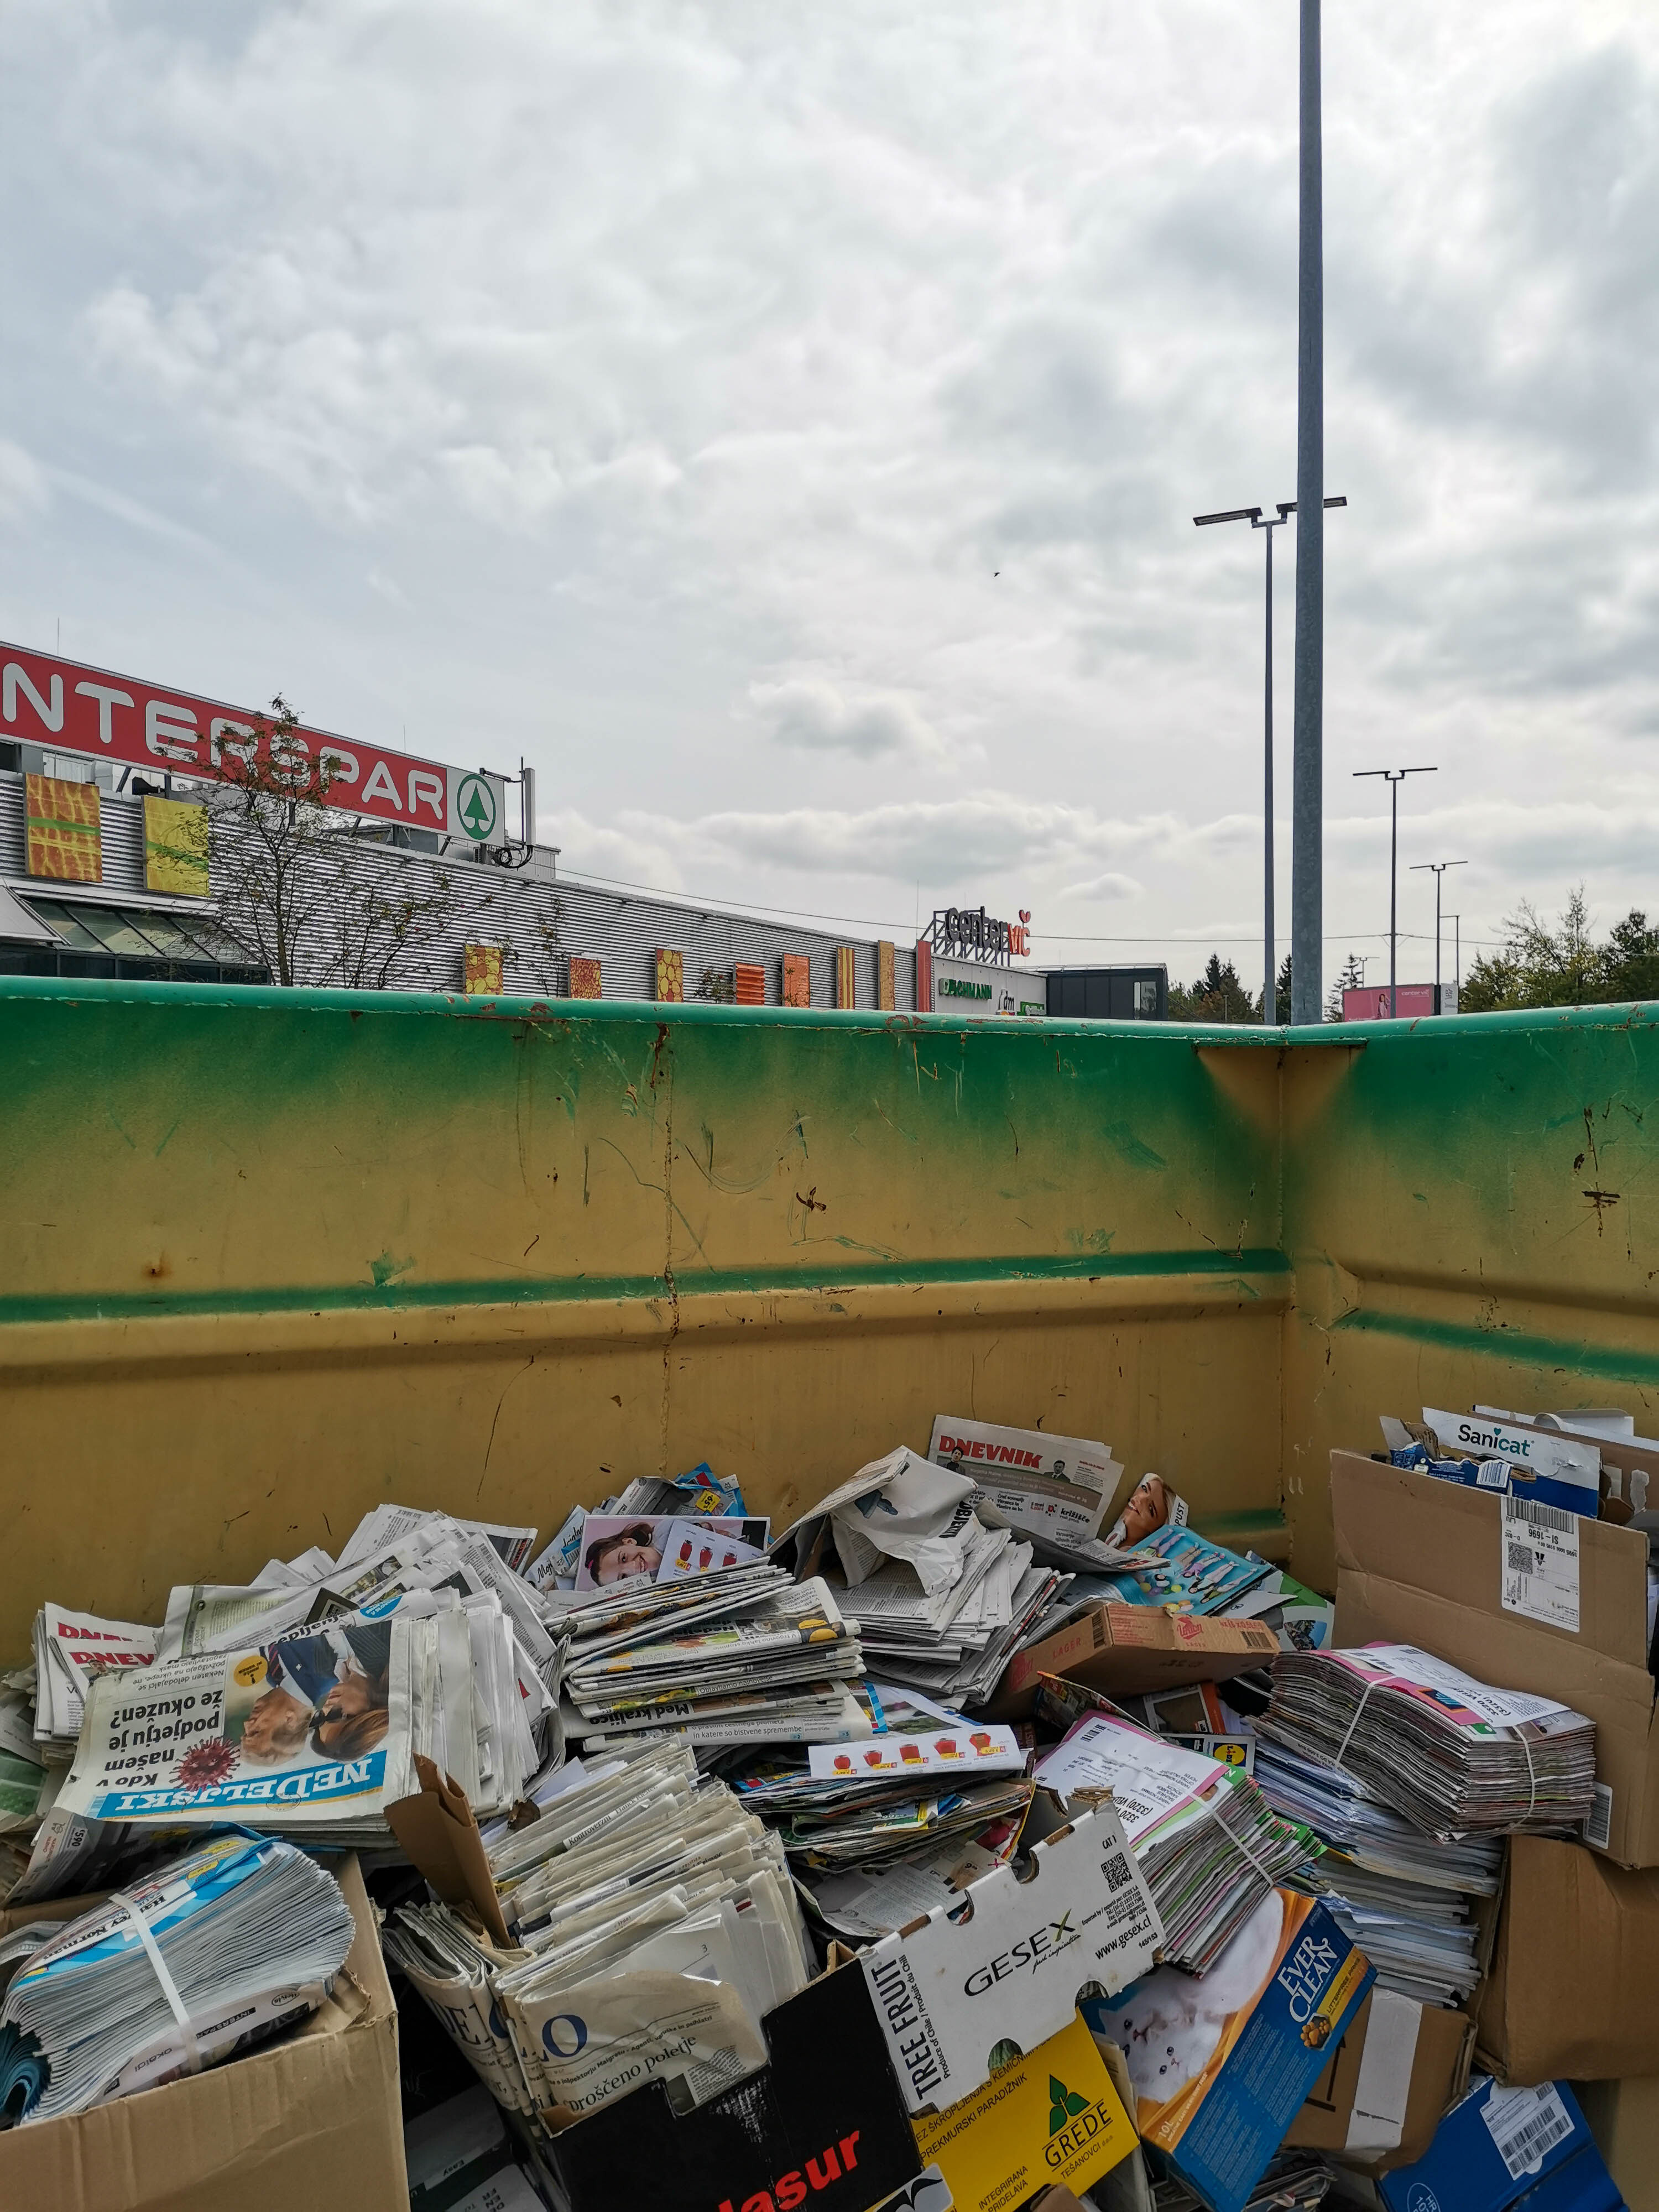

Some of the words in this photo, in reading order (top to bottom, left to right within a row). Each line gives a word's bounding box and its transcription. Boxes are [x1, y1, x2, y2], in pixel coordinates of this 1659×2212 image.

[938, 1435, 1043, 1469] DNEVNIK
[1458, 1424, 1531, 1457] Sanicat
[1060, 1507, 1091, 1524] križišče
[1174, 1503, 1185, 1526] PUST
[1052, 1637, 1082, 1659] LAGER
[110, 1696, 196, 1729] okužen?
[201, 1689, 223, 1709] že
[655, 1703, 690, 1719] Med
[109, 1729, 130, 1753] je
[133, 1710, 220, 1747] podjetju
[701, 1730, 723, 1739] katere
[734, 1726, 762, 1736] bistvene
[763, 1725, 802, 1735] spremembe
[104, 1749, 175, 1771] našem
[96, 1778, 109, 1787] v
[114, 1757, 374, 1812] NEDELJSKI
[115, 1773, 158, 1787] Kdo
[1128, 1798, 1154, 1816] (3320)
[1102, 1835, 1113, 1850] CAT
[964, 1908, 1076, 1997] GESEX
[1095, 1914, 1152, 1960] www.gesex.cl
[898, 1953, 910, 1972] Chili
[1276, 1936, 1329, 1996] EVER
[870, 1959, 919, 2036] FRUIT
[911, 1983, 926, 2013] Produit
[1288, 1948, 1339, 2022] CLEAN
[925, 2018, 936, 2038] Chile
[563, 2063, 641, 2114] proščeno
[643, 2033, 698, 2075] poletje
[899, 2031, 943, 2101] TREE
[935, 2047, 952, 2080] Produce
[920, 2114, 978, 2162] PREKMURSKI
[976, 2071, 1028, 2117] PARADIŽNIK
[1045, 2101, 1113, 2167] GREDE
[1060, 2143, 1102, 2180] TEŠANOVCI
[978, 2165, 1029, 2211] INTEGRIRANA
